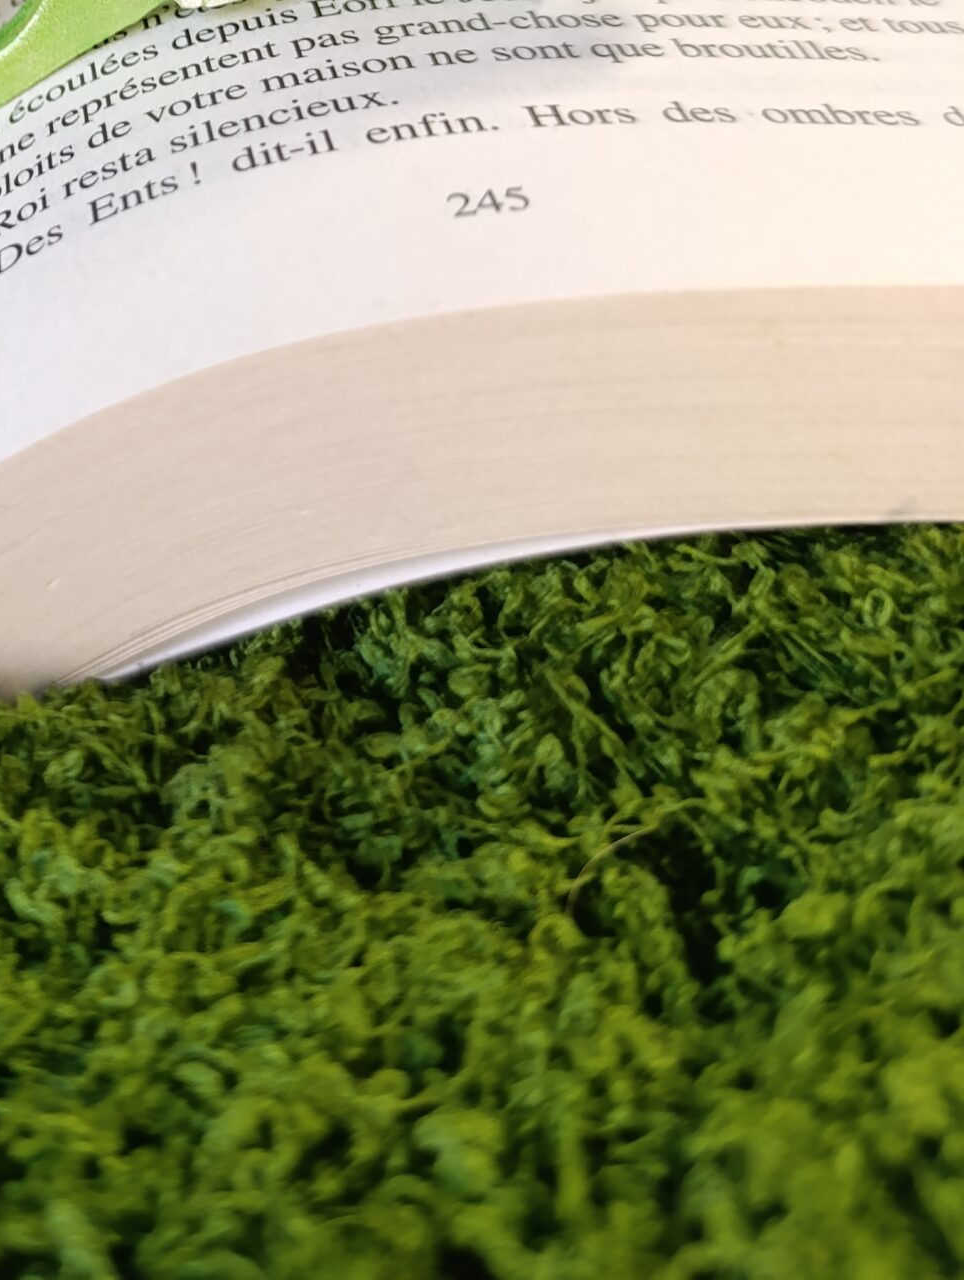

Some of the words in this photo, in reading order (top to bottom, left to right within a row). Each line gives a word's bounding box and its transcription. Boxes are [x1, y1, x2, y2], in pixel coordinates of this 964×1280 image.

[8, 44, 159, 125] écoulées
[171, 8, 298, 51] depuis
[46, 41, 280, 138] représentent
[290, 28, 360, 59] pas
[374, 10, 624, 45] grand-chose
[634, 12, 727, 33] pour
[839, 16, 878, 33] et
[882, 17, 964, 35] tous
[87, 120, 133, 150] de
[144, 82, 248, 124] votre
[260, 52, 416, 94] maison
[427, 48, 478, 67] ne
[490, 41, 581, 62] sont
[590, 42, 666, 64] que
[669, 38, 881, 62] broutilles.
[62, 146, 157, 200] resta
[170, 91, 399, 155] silencieux.
[231, 129, 340, 174] dit-il
[365, 111, 499, 145] enfin.
[522, 104, 638, 129] Hors
[662, 100, 737, 126] des
[761, 103, 922, 126] ombres
[446, 185, 532, 218] 245
